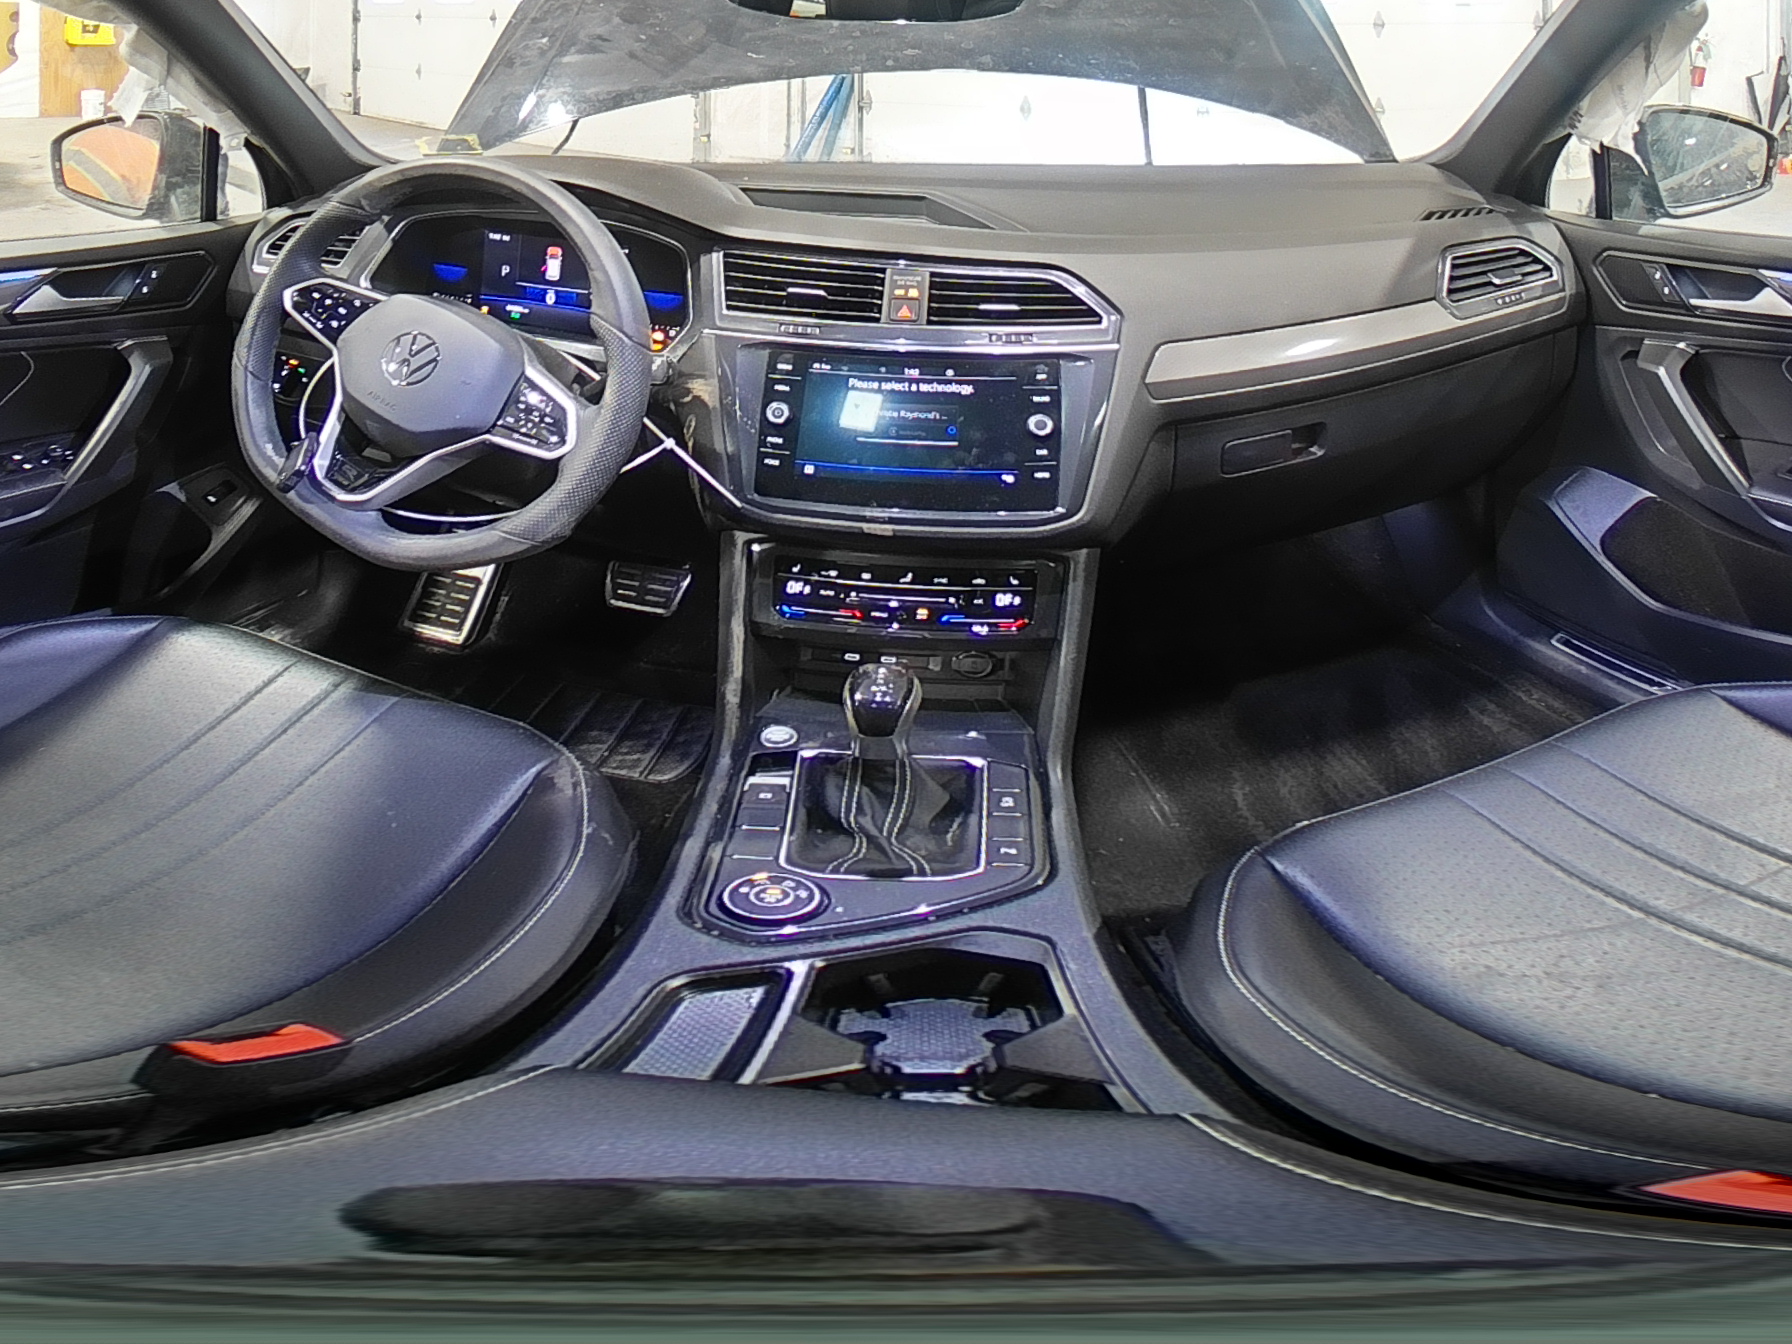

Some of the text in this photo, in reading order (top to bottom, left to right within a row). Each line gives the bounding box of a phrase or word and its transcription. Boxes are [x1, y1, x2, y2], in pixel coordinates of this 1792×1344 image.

[501, 264, 511, 277] P
[848, 377, 975, 396] Please select a technology.
